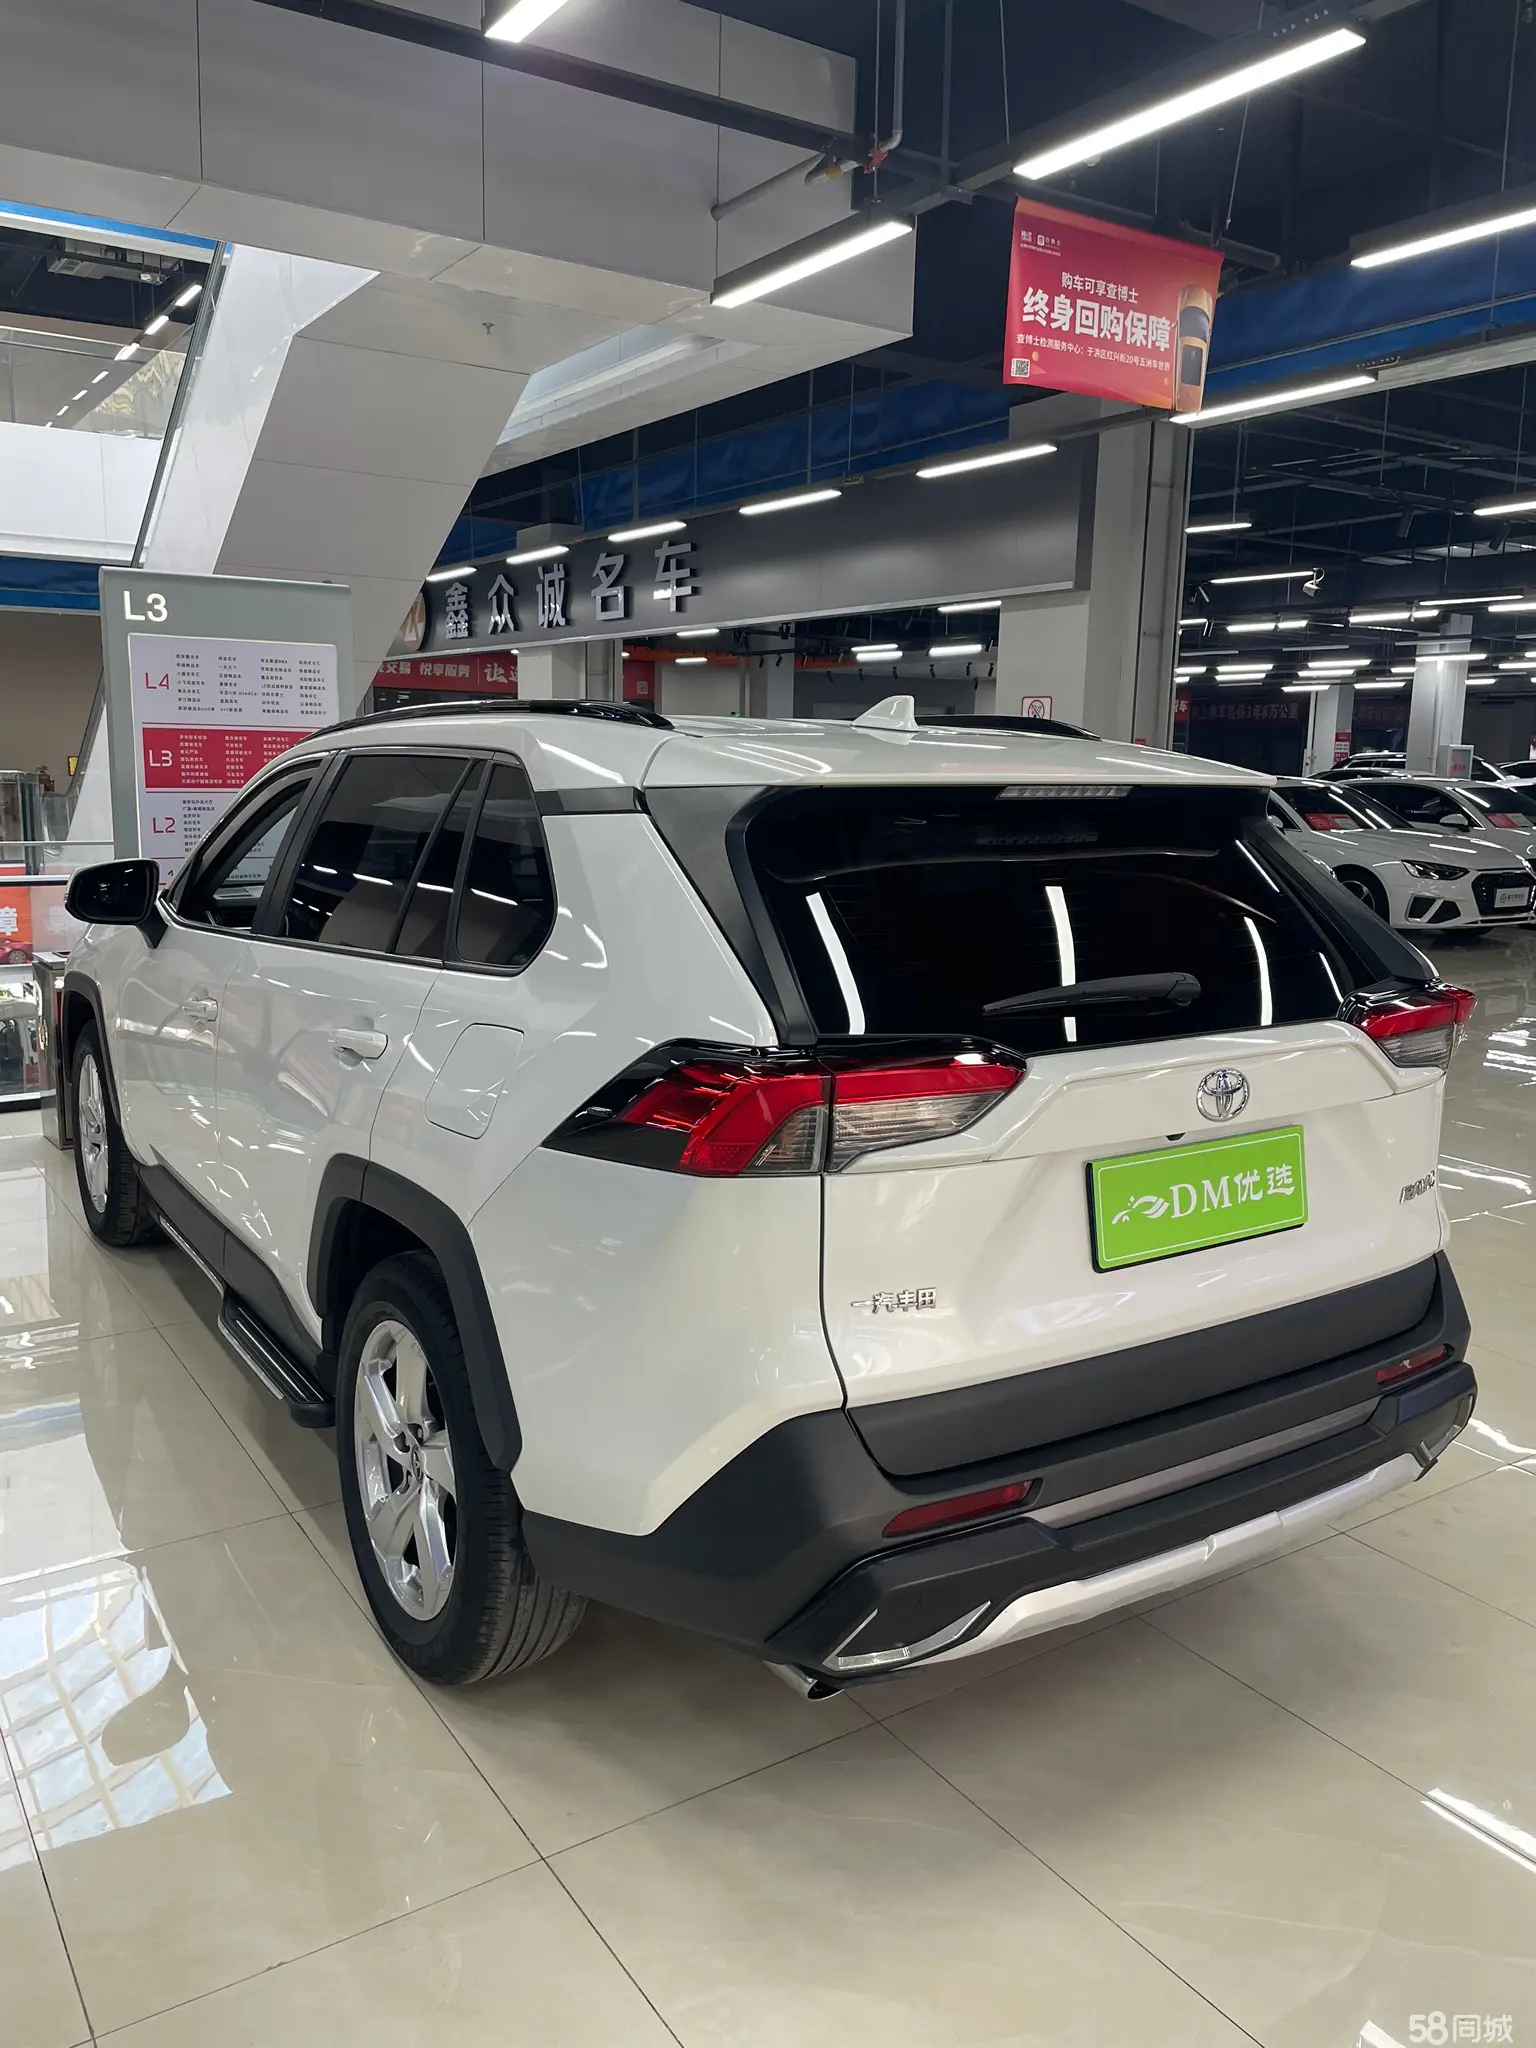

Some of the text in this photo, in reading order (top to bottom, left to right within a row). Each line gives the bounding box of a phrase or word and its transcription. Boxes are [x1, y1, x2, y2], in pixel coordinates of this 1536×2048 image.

[1061, 272, 1139, 304] 购车可享查博士
[1022, 286, 1170, 352] 终身回购保障
[445, 540, 694, 639] 鑫众诚名车
[123, 590, 168, 622] L3
[144, 672, 170, 690] L4
[420, 662, 470, 678] 悦享服务
[148, 749, 173, 767] L3
[152, 816, 176, 834] L2
[1170, 1163, 1296, 1219] DM优选
[850, 1287, 937, 1314] 一汽丰田
